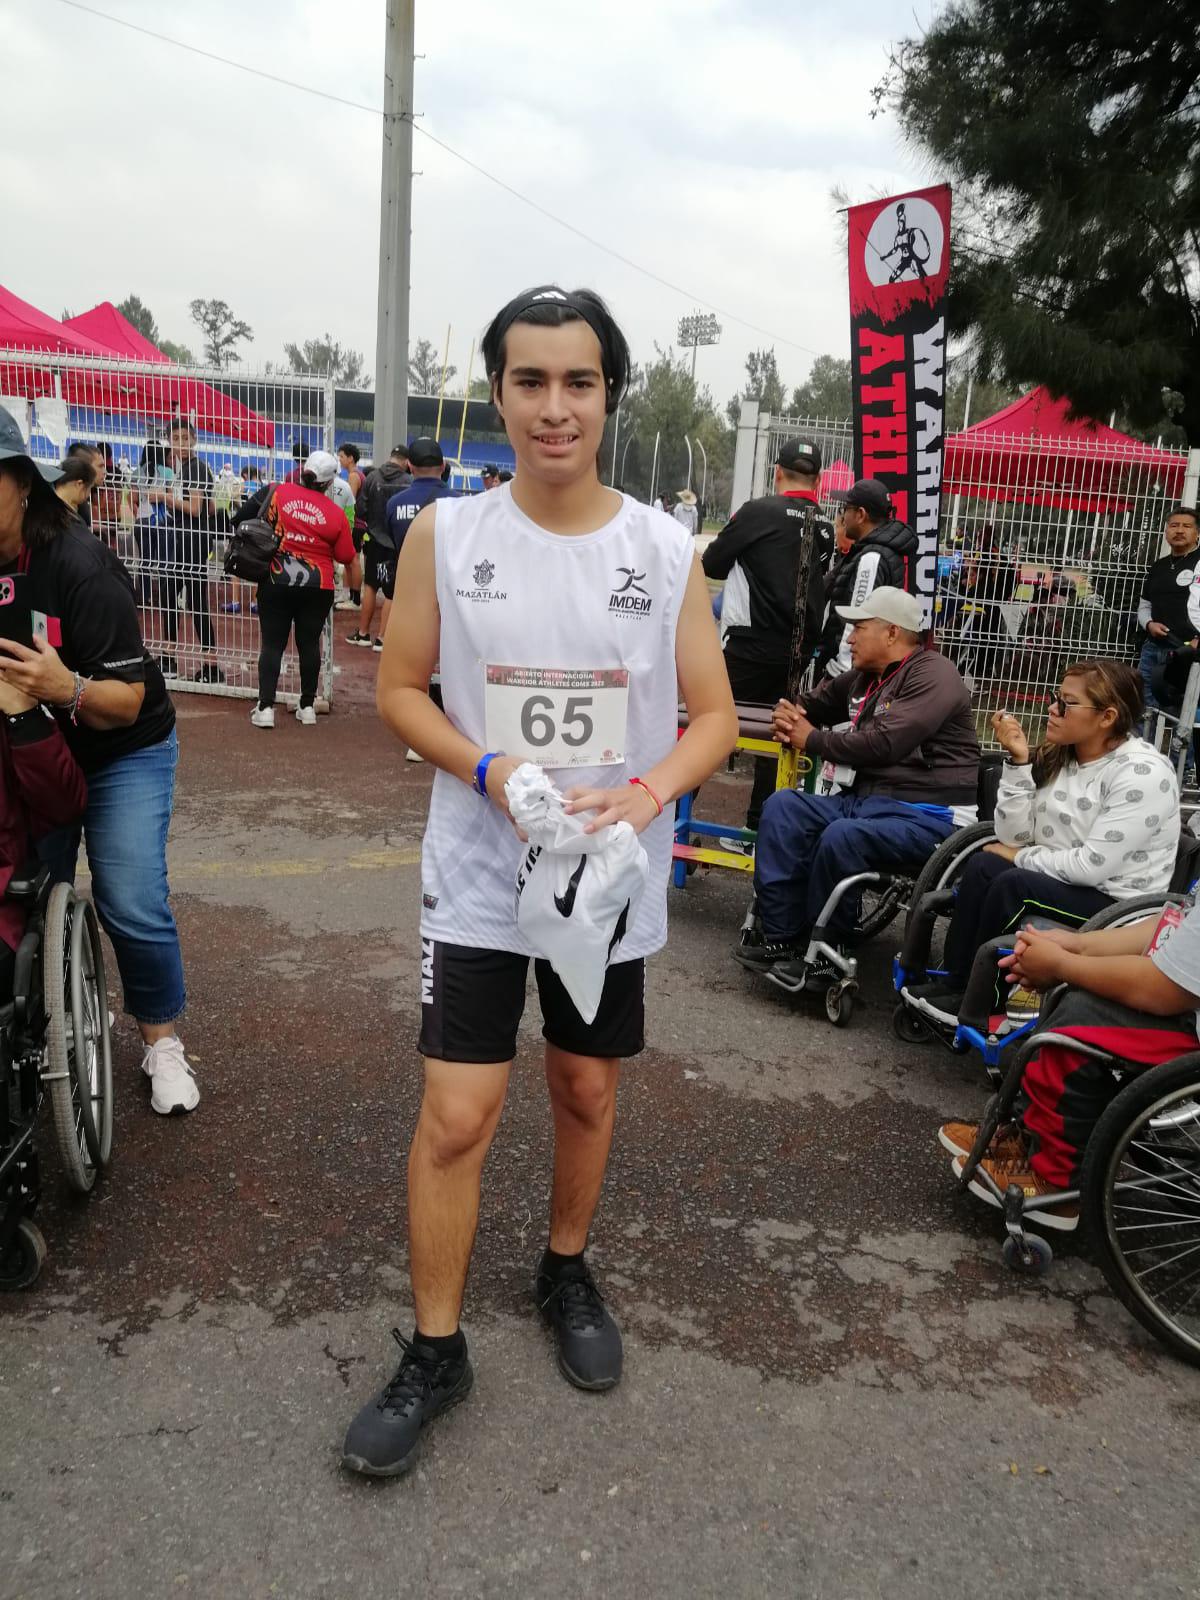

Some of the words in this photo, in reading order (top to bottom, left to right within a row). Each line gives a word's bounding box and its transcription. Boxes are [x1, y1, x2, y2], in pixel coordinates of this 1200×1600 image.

[396, 504, 421, 521] ME
[455, 588, 508, 600] MAZATLÁN
[608, 594, 652, 611] IMDEM
[506, 677, 537, 686] WARRIOR
[514, 670, 542, 678] ABIERTO
[543, 672, 595, 680] INTERNACIONAL
[520, 695, 594, 747] 65
